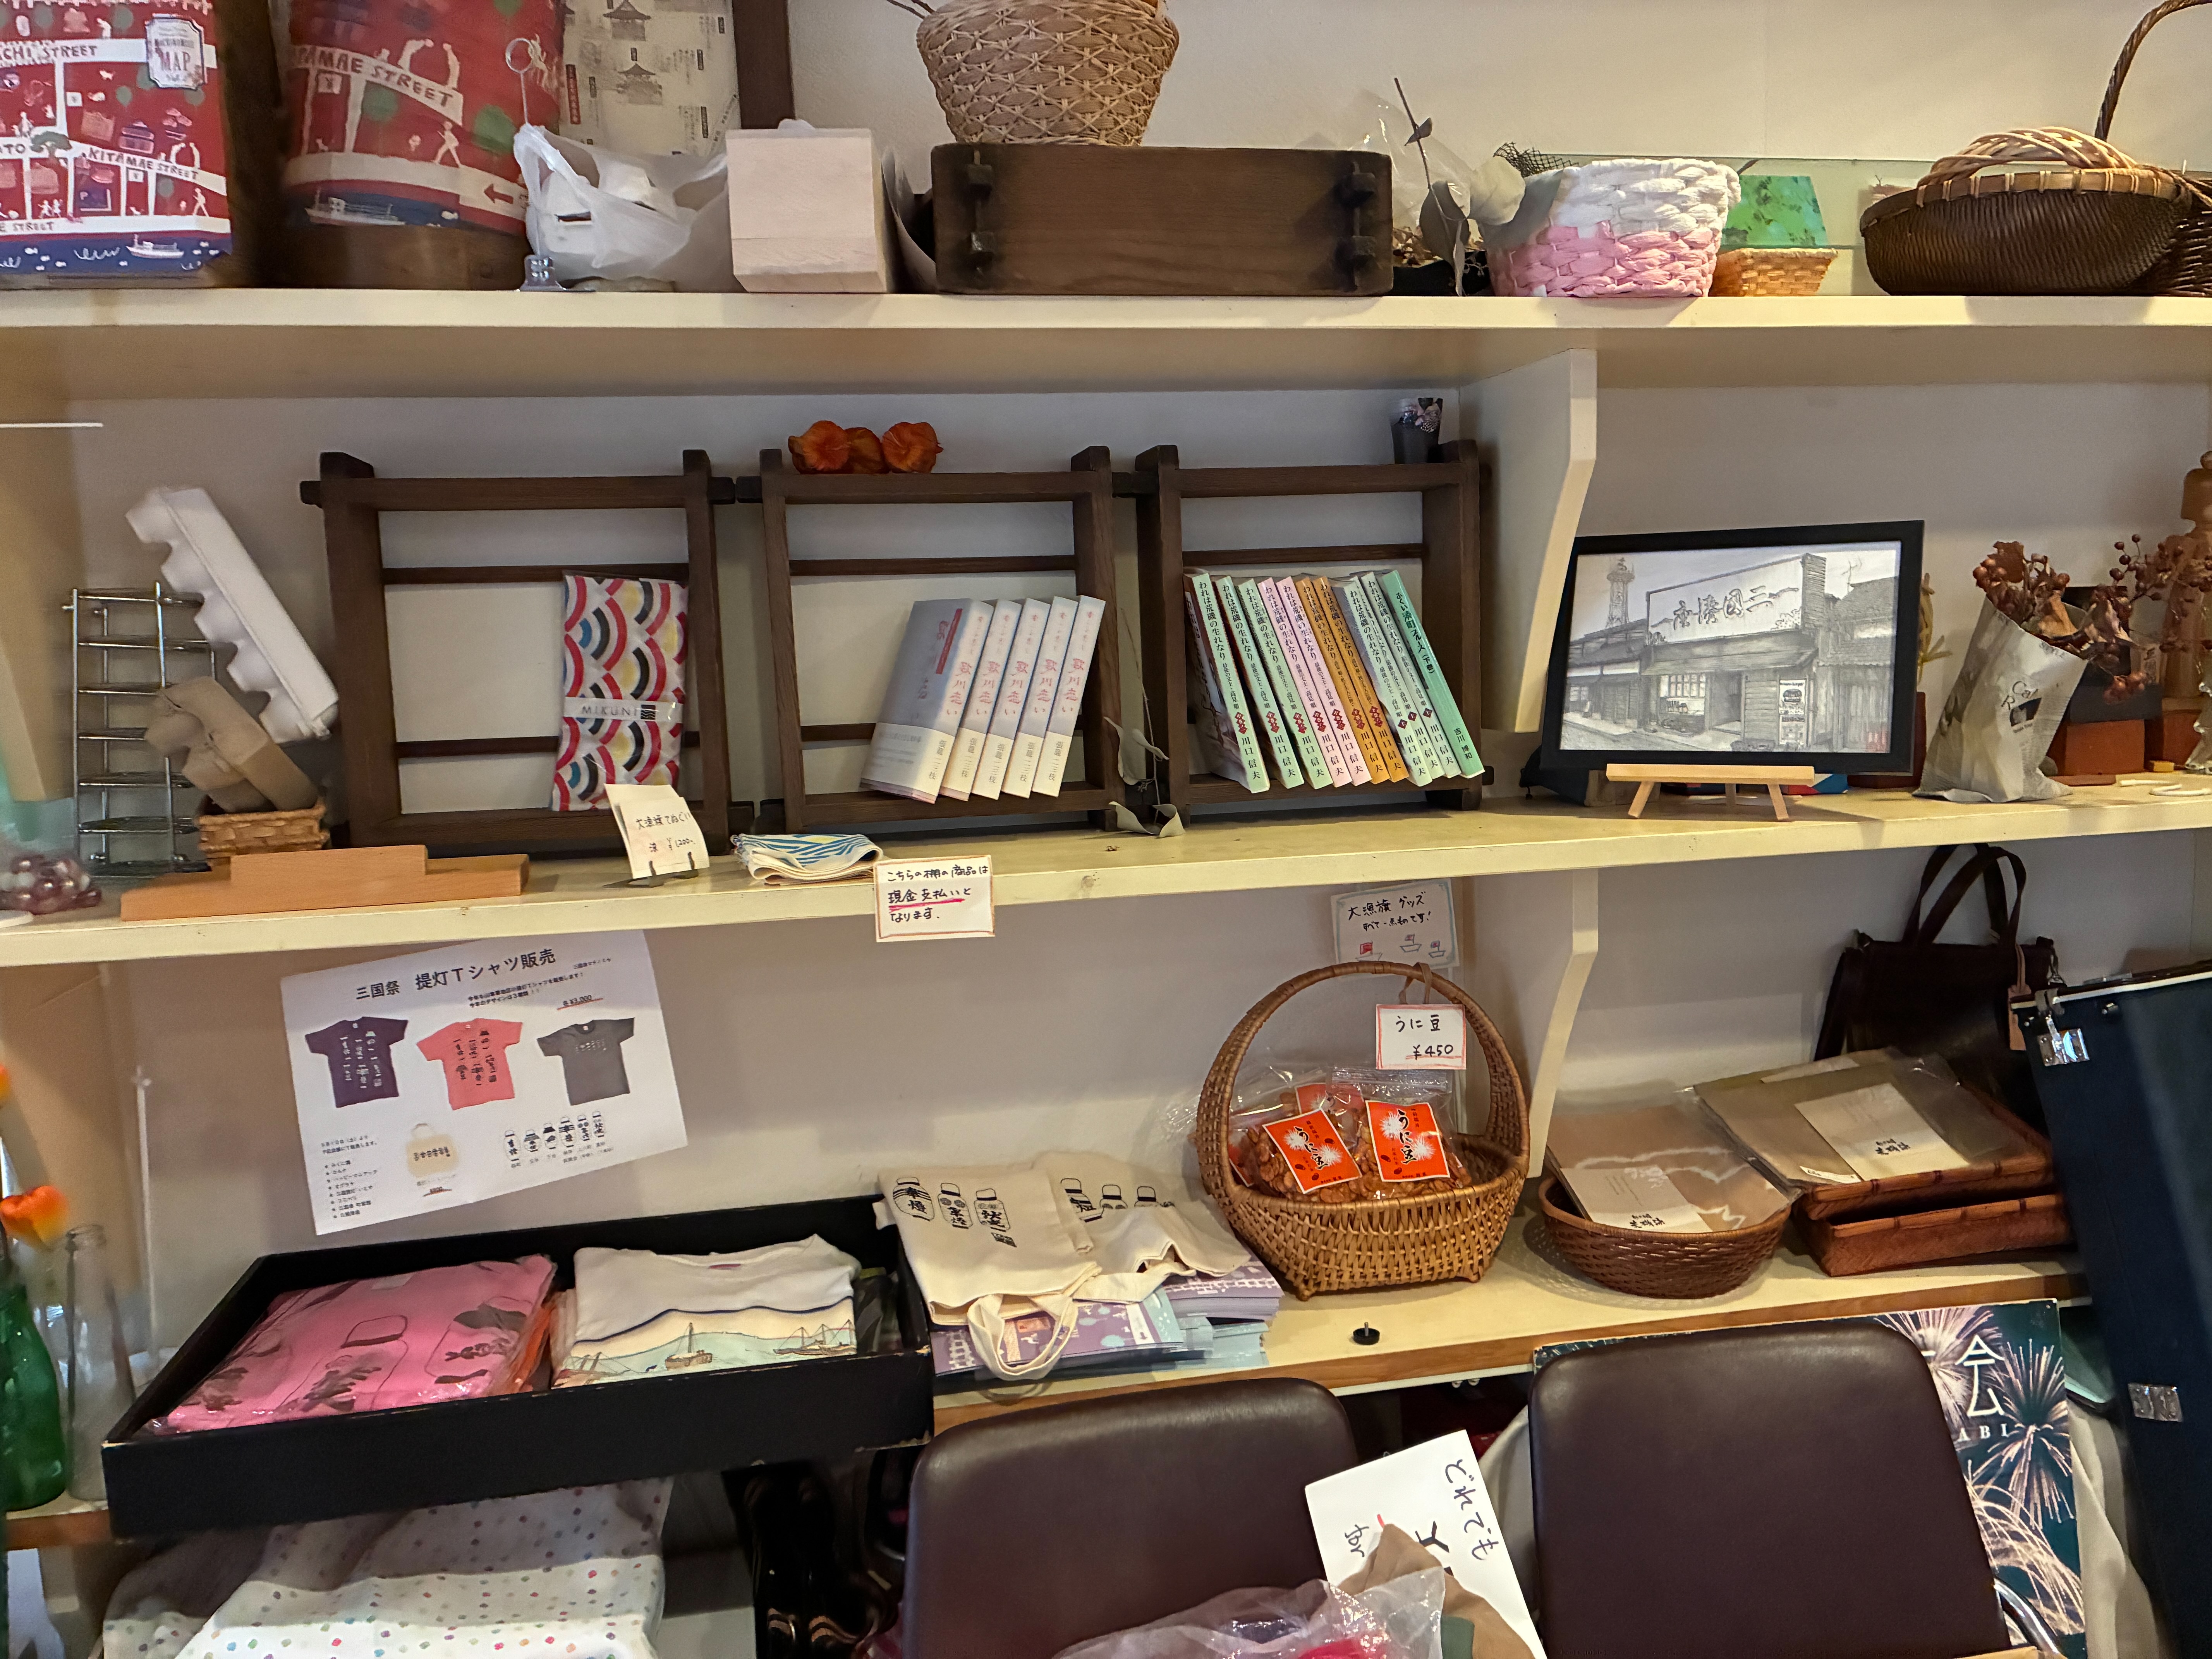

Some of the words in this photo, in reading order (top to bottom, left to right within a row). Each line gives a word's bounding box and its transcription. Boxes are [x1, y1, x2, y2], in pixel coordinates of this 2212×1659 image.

[43, 45, 98, 58] STREET
[155, 48, 191, 71] MAP
[371, 65, 453, 107] STREET
[88, 147, 154, 171] KITAMAE
[157, 162, 199, 180] STREET
[582, 706, 637, 716] MIKUNI
[1241, 737, 1261, 779] 川口信夫
[1274, 735, 1296, 777] 川口信夫
[1302, 735, 1324, 777] 川口信夫
[1322, 734, 1344, 776] 川口信夫
[1341, 732, 1364, 774] 川口信夫
[1360, 731, 1383, 773] 川口信夫
[1379, 729, 1401, 771] 川口信夫
[1405, 735, 1426, 776] 川口信夫
[1415, 727, 1438, 768] 川口信夫
[1431, 724, 1454, 766] 川口信夫
[888, 864, 989, 882] こちらの棚の商品は
[888, 888, 971, 904] 現金支払いと
[1348, 898, 1392, 921] 大漁旗
[1399, 891, 1426, 909] グッズ
[356, 980, 401, 1000] 三国祭
[415, 948, 556, 991] 提灯Tシャツ販売
[1396, 1014, 1441, 1032] うに豆
[1413, 1044, 1454, 1060] ¥450
[1293, 1126, 1329, 1170] うに豆
[1396, 1109, 1418, 1165] うに豆
[1444, 1458, 1499, 1561] どれでも
